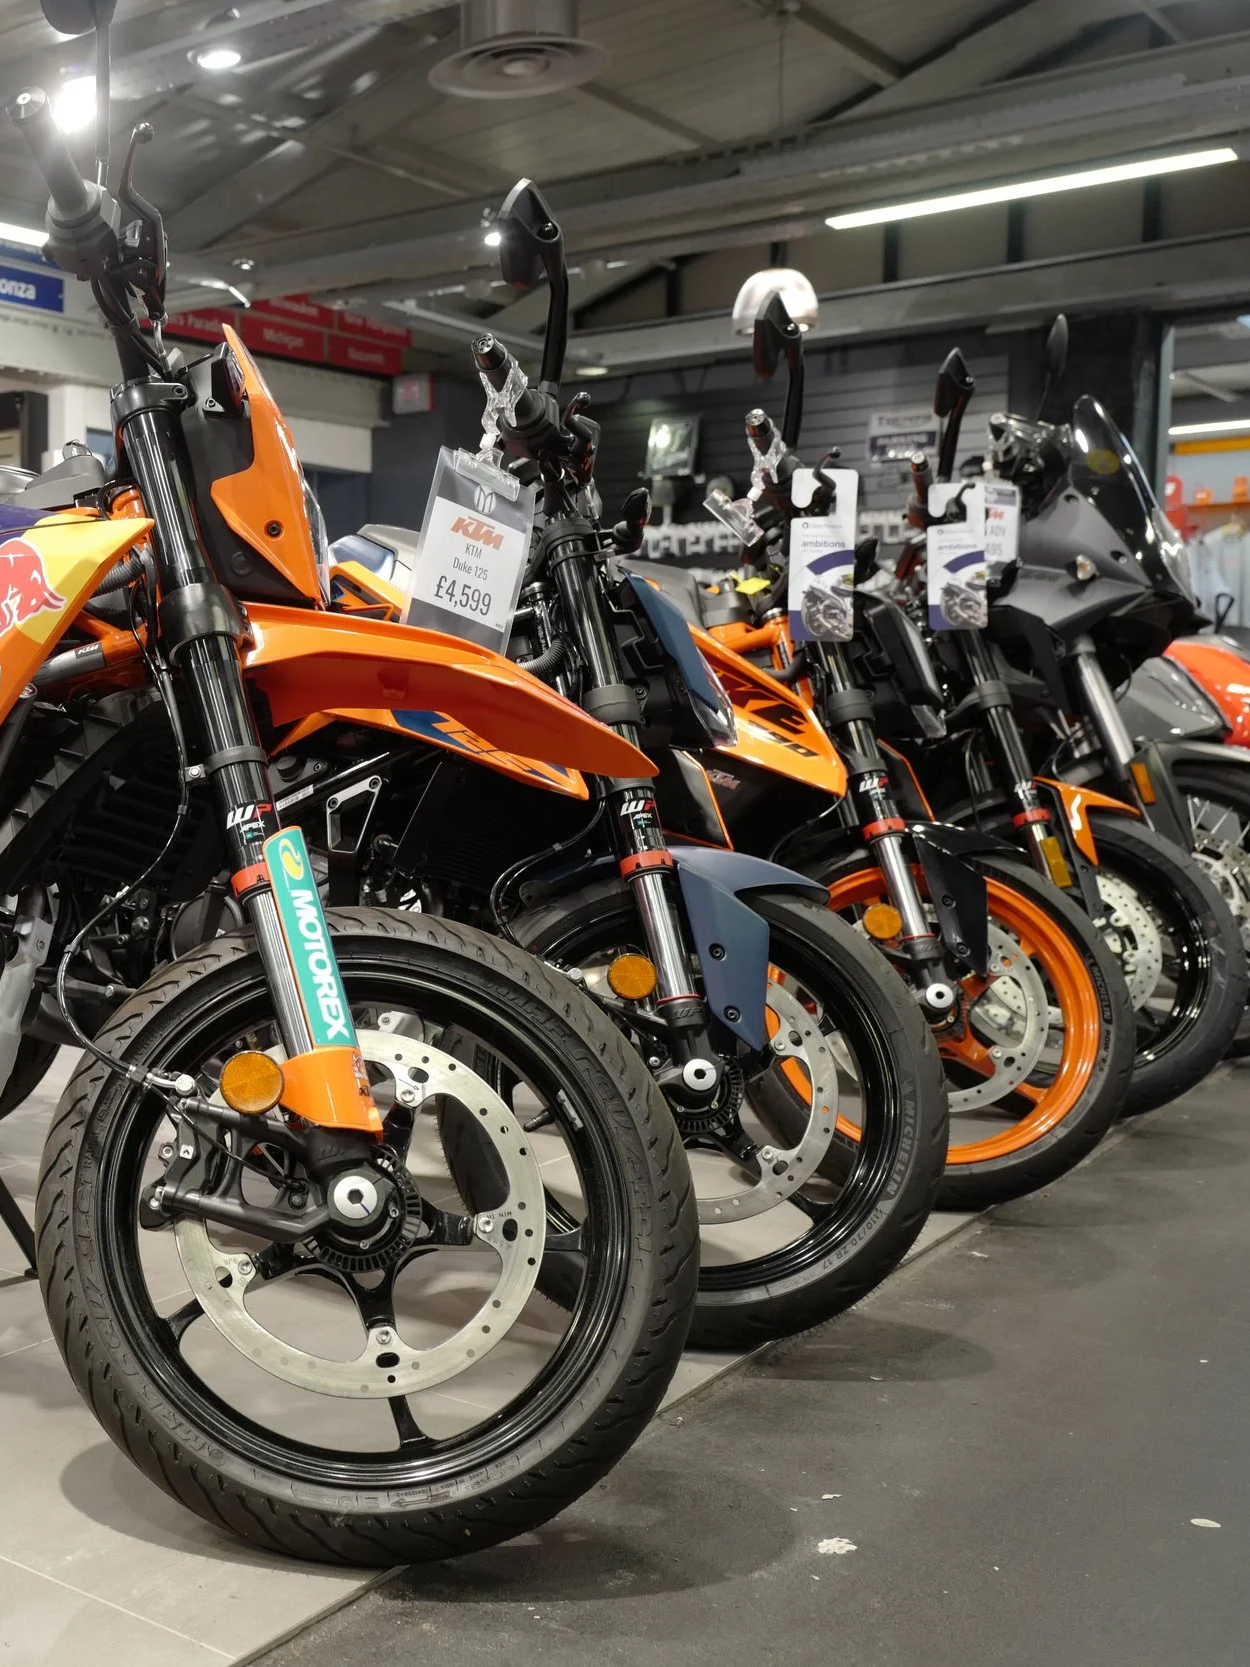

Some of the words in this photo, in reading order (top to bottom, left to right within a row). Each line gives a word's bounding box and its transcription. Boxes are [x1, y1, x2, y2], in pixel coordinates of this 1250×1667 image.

[450, 515, 505, 550] KTM
[801, 540, 846, 548] ambitions
[465, 543, 482, 559] KTM
[452, 557, 472, 575] Duke
[474, 565, 489, 581] 125
[434, 575, 492, 616] £4,599
[227, 804, 273, 829] WP
[290, 888, 350, 1041] MOTOREX
[886, 1099, 916, 1199] MICHELIN
[851, 1211, 883, 1246] 110/70
[823, 1258, 832, 1270] 17
[835, 1246, 850, 1260] ZR
